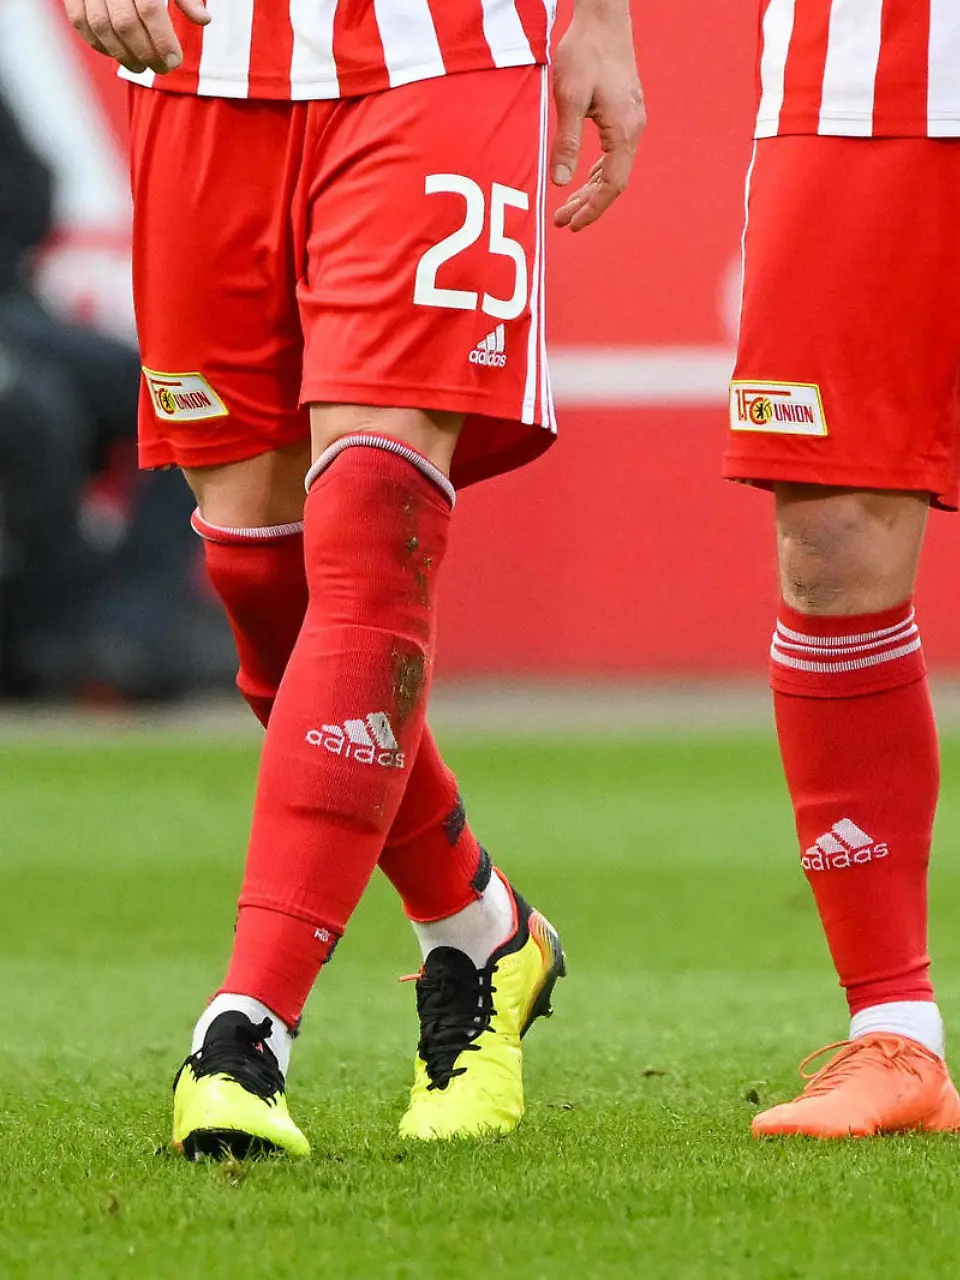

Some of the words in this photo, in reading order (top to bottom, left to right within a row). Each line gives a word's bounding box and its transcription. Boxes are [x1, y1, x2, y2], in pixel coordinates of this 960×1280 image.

[413, 173, 530, 321] 25
[468, 349, 508, 367] adidas
[773, 403, 815, 423] UNION
[305, 729, 406, 769] adidas
[800, 841, 889, 871] adidas
